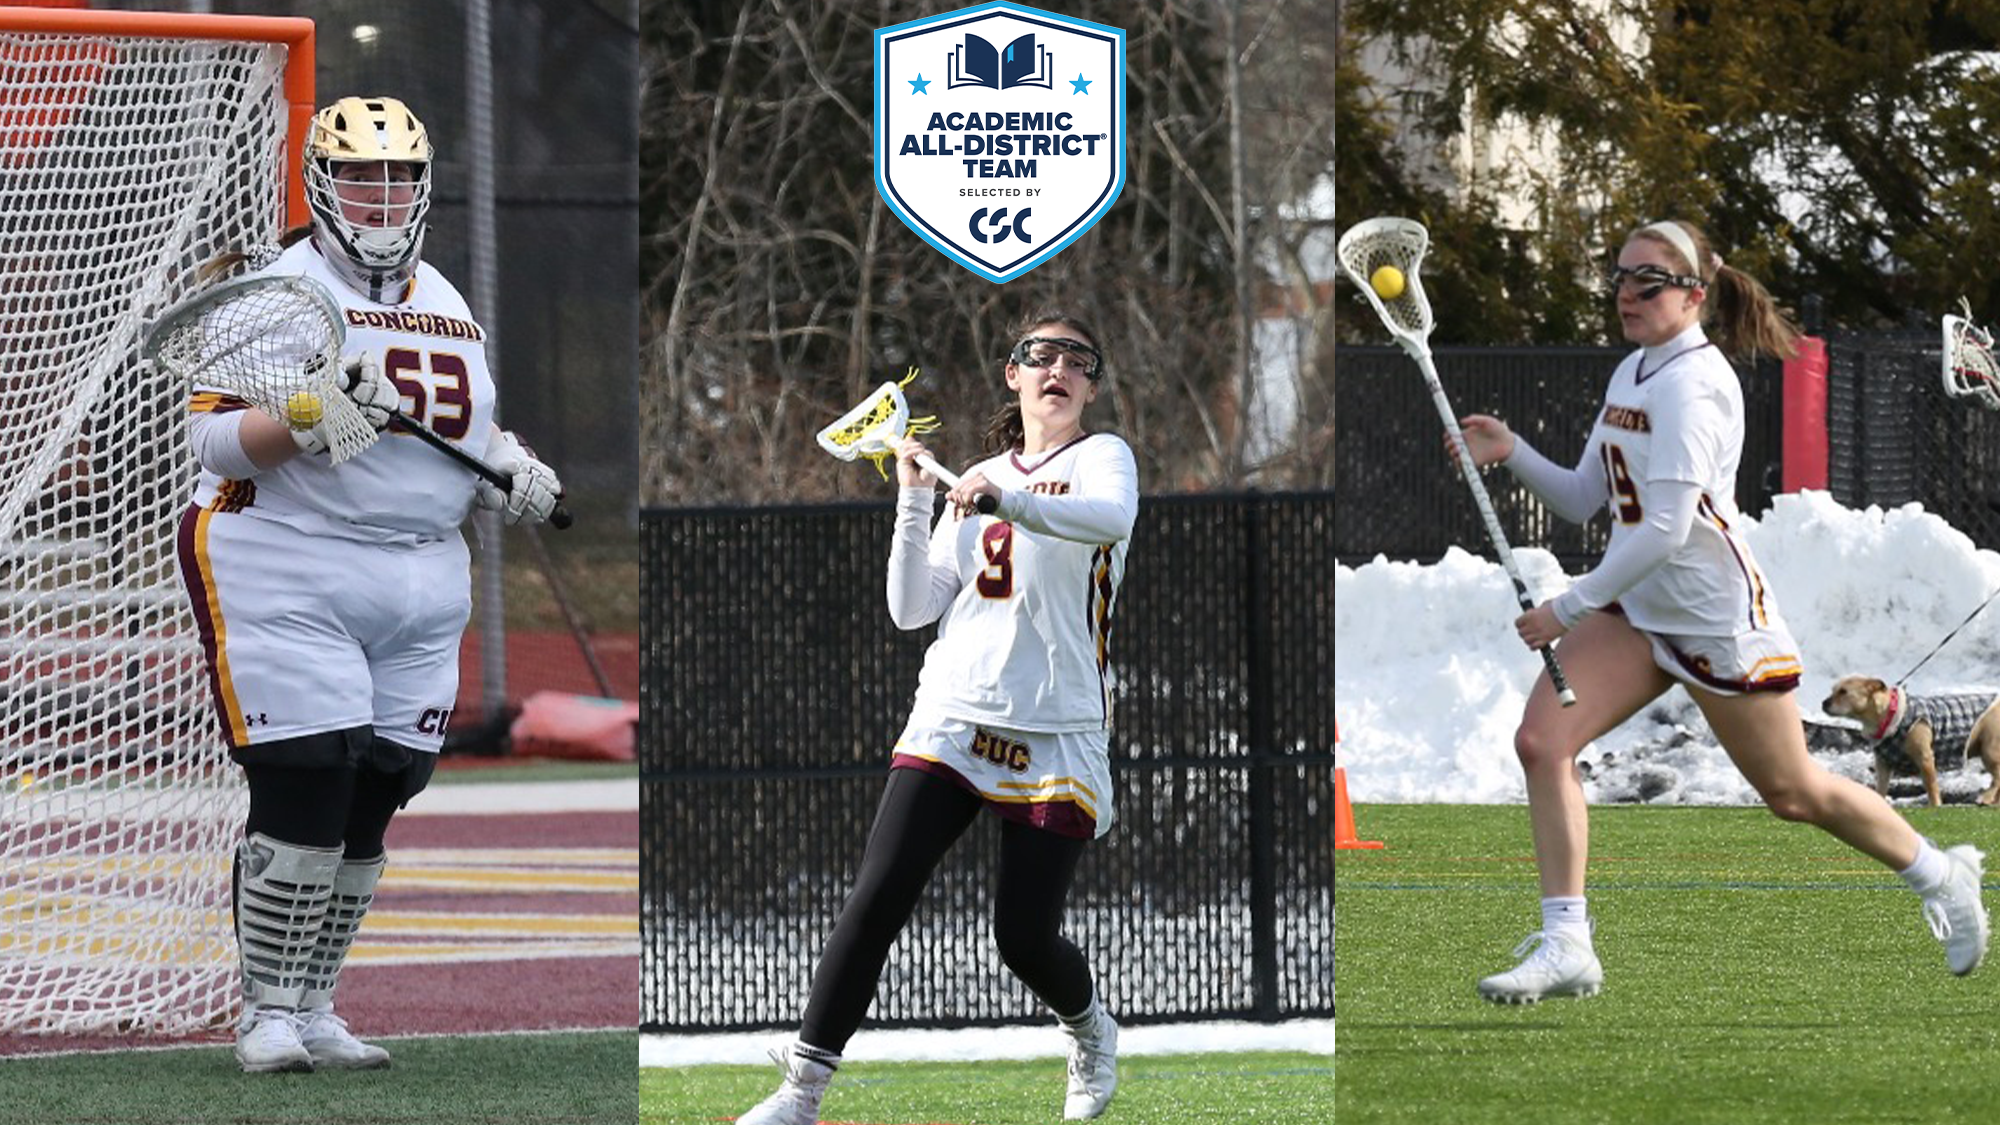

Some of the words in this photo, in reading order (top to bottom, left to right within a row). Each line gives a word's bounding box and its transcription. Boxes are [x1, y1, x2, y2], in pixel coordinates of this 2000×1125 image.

[385, 347, 473, 441] 53
[1601, 442, 1644, 525] 19
[976, 520, 1014, 600] 9
[968, 726, 1032, 774] CUC
